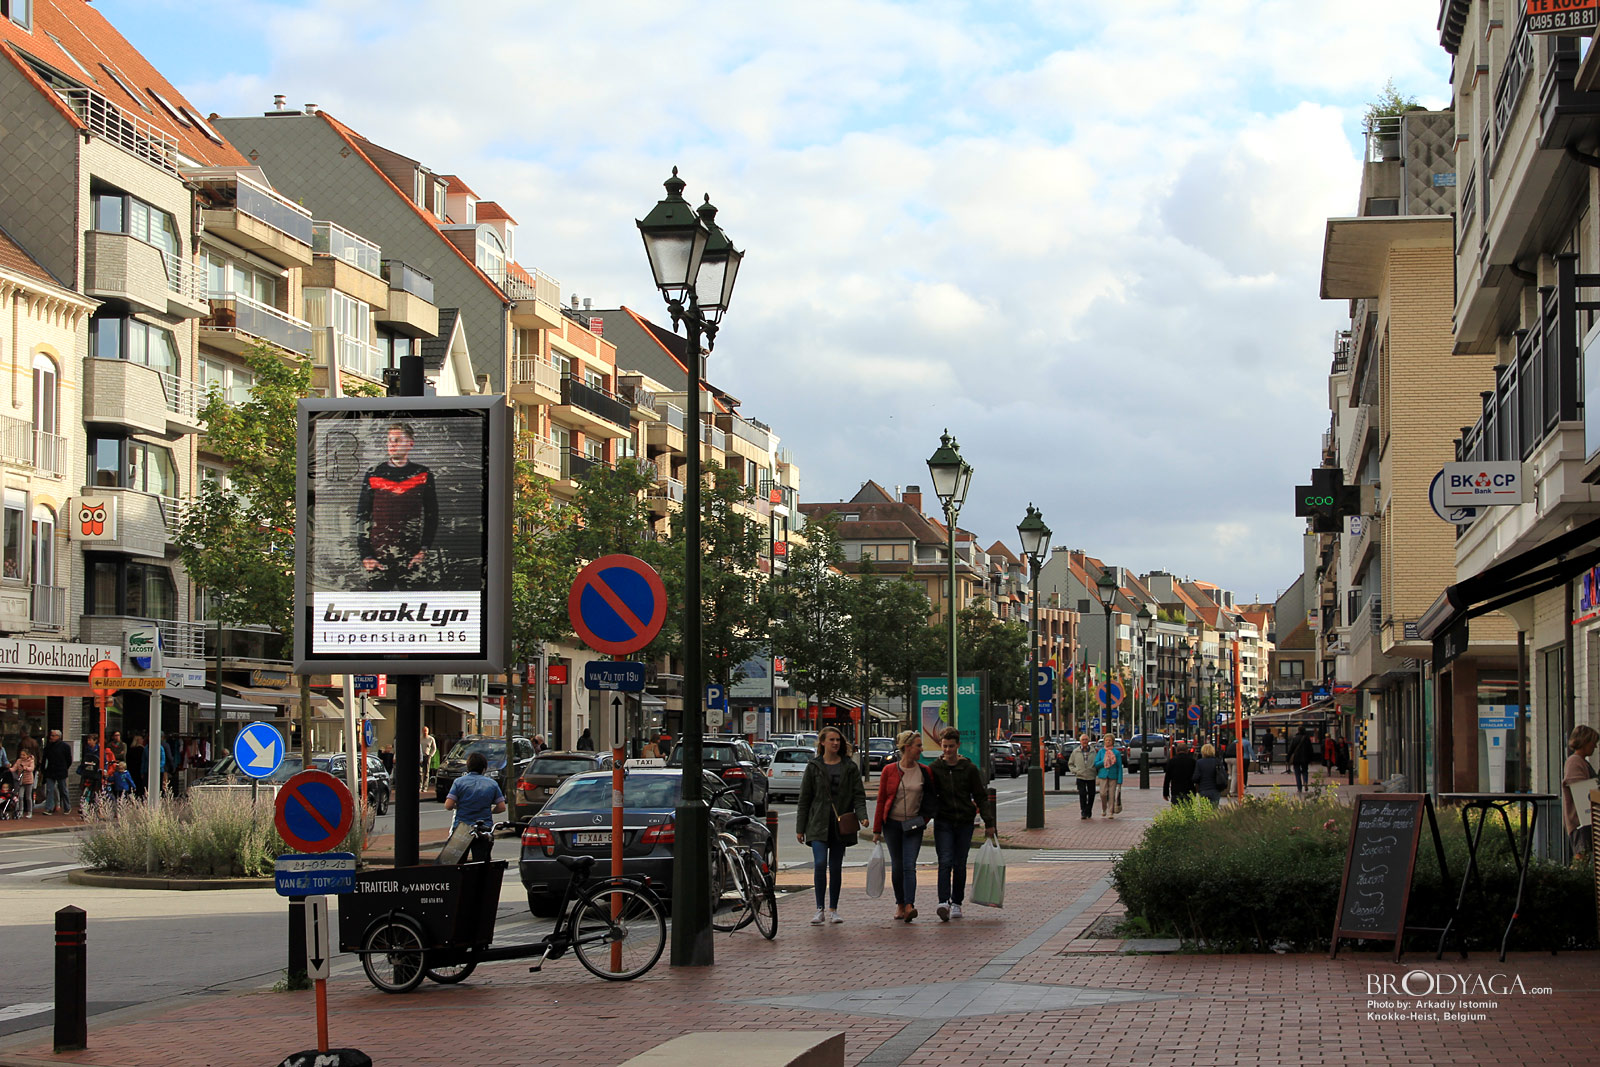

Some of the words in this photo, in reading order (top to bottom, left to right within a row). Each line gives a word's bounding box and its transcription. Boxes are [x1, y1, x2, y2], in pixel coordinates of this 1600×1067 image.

[1532, 0, 1548, 11] TE
[1530, 15, 1552, 30] 0495
[1554, 13, 1566, 27] 62
[1569, 11, 1580, 25] 18
[1582, 10, 1593, 24] 81
[1451, 474, 1473, 487] BK
[1493, 474, 1515, 487] CP
[323, 632, 427, 644] lippenslaan
[437, 631, 466, 642] 186
[28, 644, 99, 668] Boekhandel
[102, 678, 126, 687] Manoir
[128, 679, 136, 687] du
[138, 679, 164, 688] Dragon
[589, 673, 601, 681] VAN
[614, 673, 625, 681] TOT
[921, 684, 948, 695] Best
[957, 683, 976, 695] eal
[707, 688, 720, 705] P
[1167, 704, 1175, 716] P
[279, 879, 295, 889] VAN
[353, 883, 359, 893] E
[360, 881, 399, 893] TRAITEUR
[402, 885, 409, 894] by
[409, 882, 450, 892] VANDYCKE
